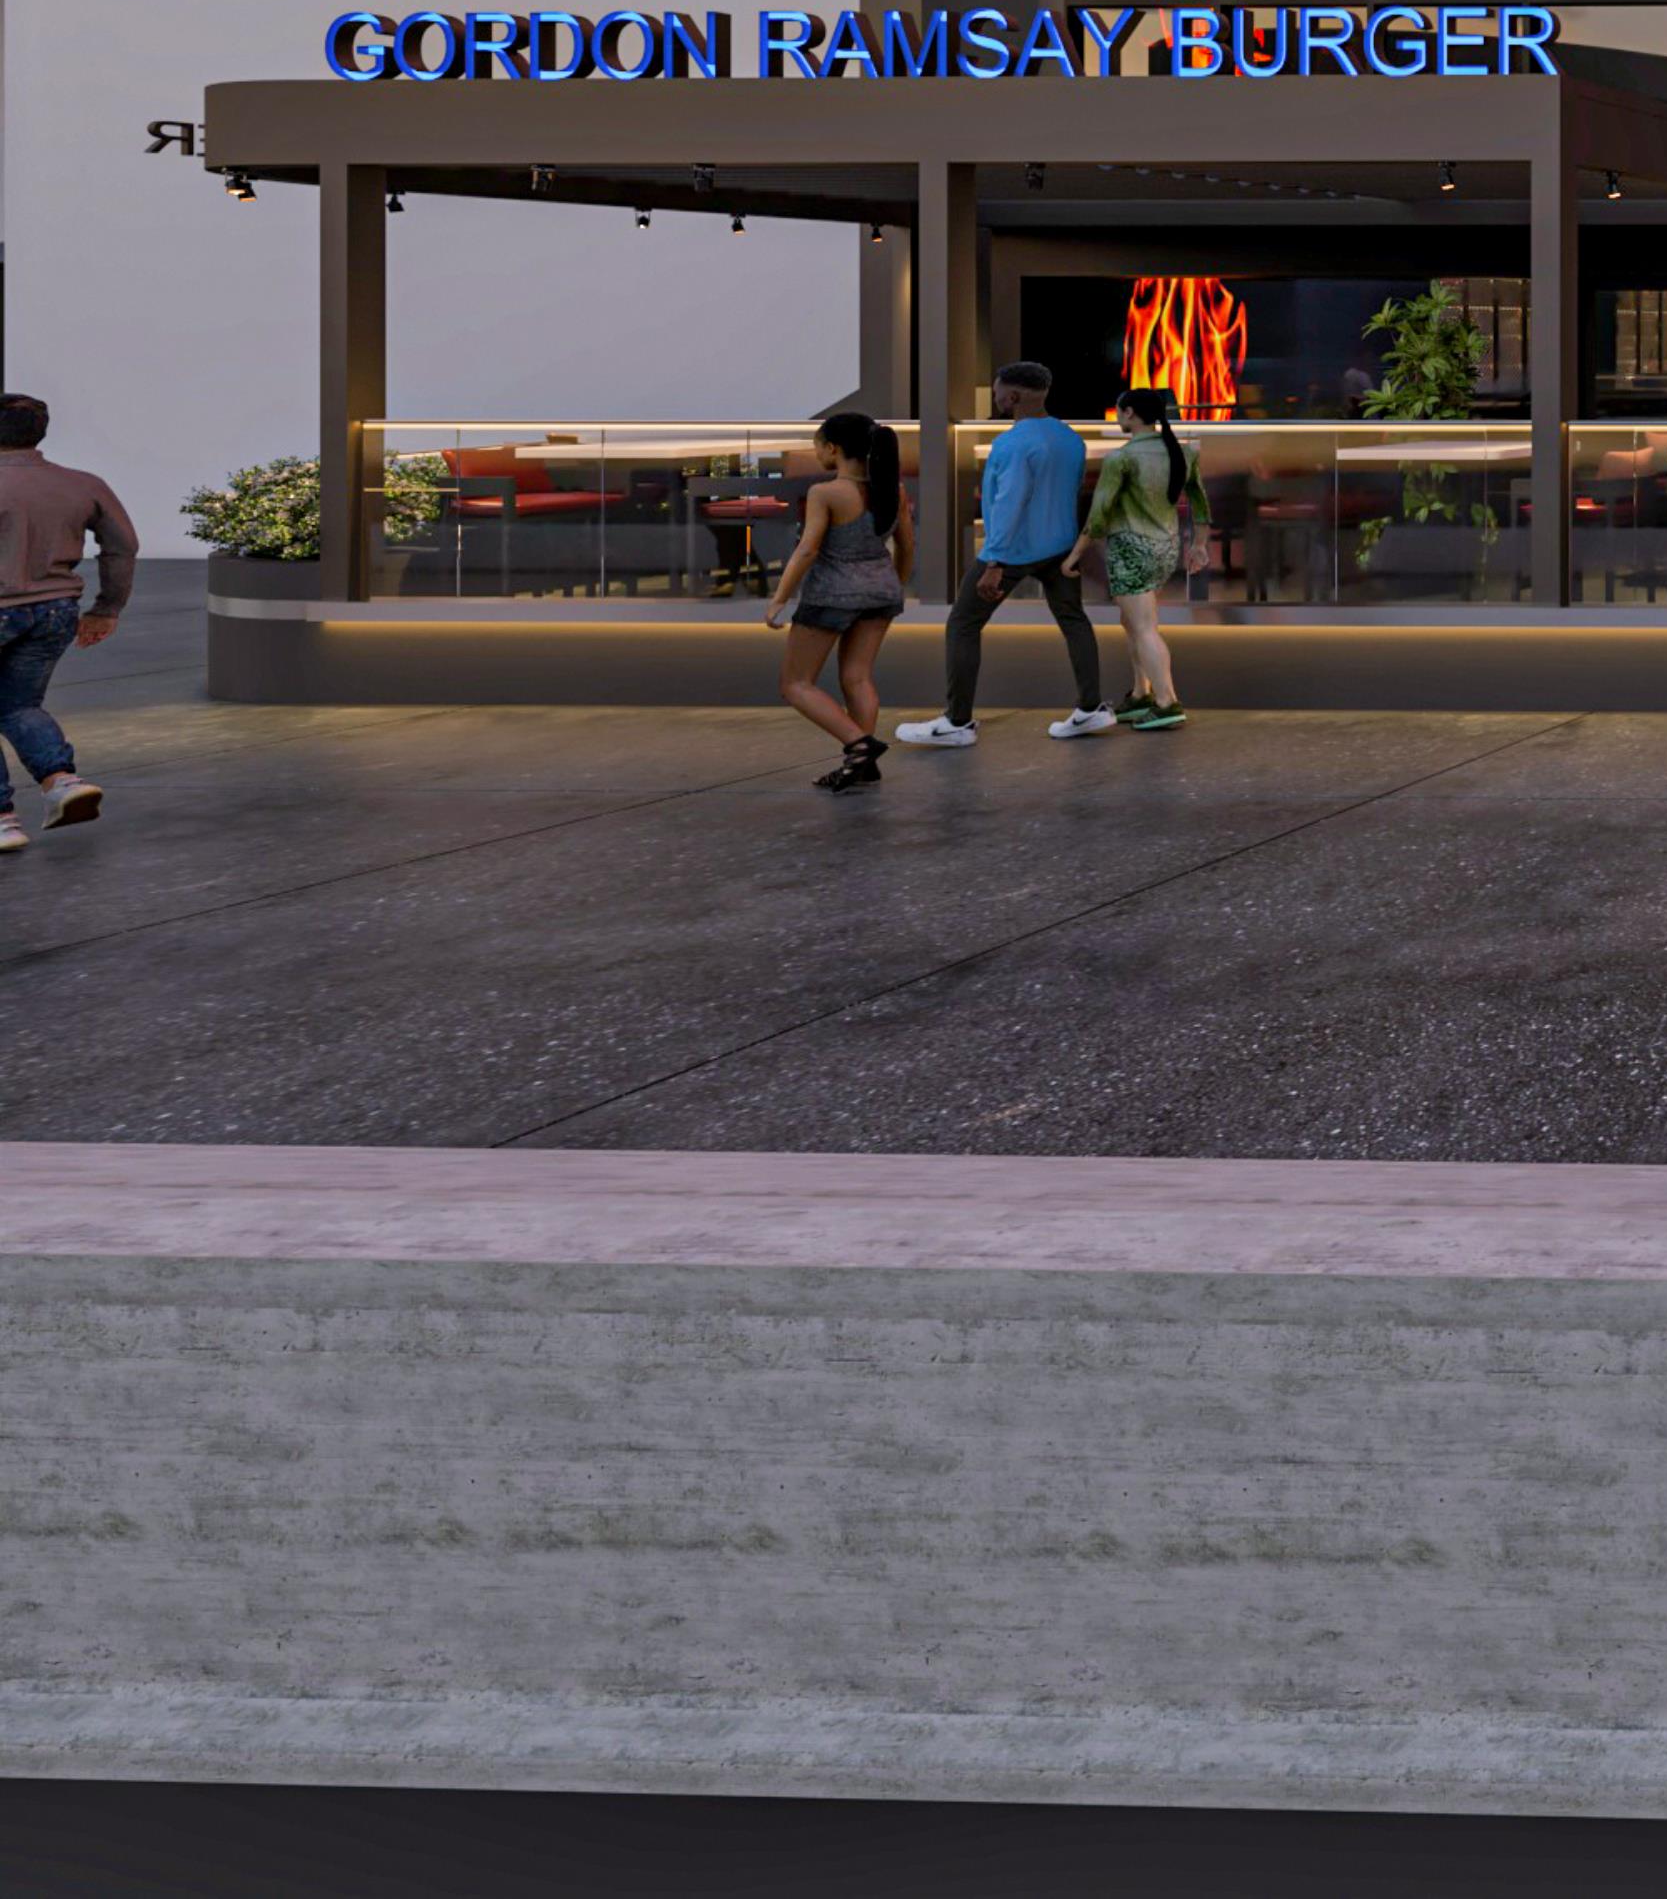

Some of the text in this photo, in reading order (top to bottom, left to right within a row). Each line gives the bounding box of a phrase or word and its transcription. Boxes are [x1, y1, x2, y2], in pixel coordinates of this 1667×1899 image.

[325, 5, 1558, 81] GORDON RAMSAY BURGER
